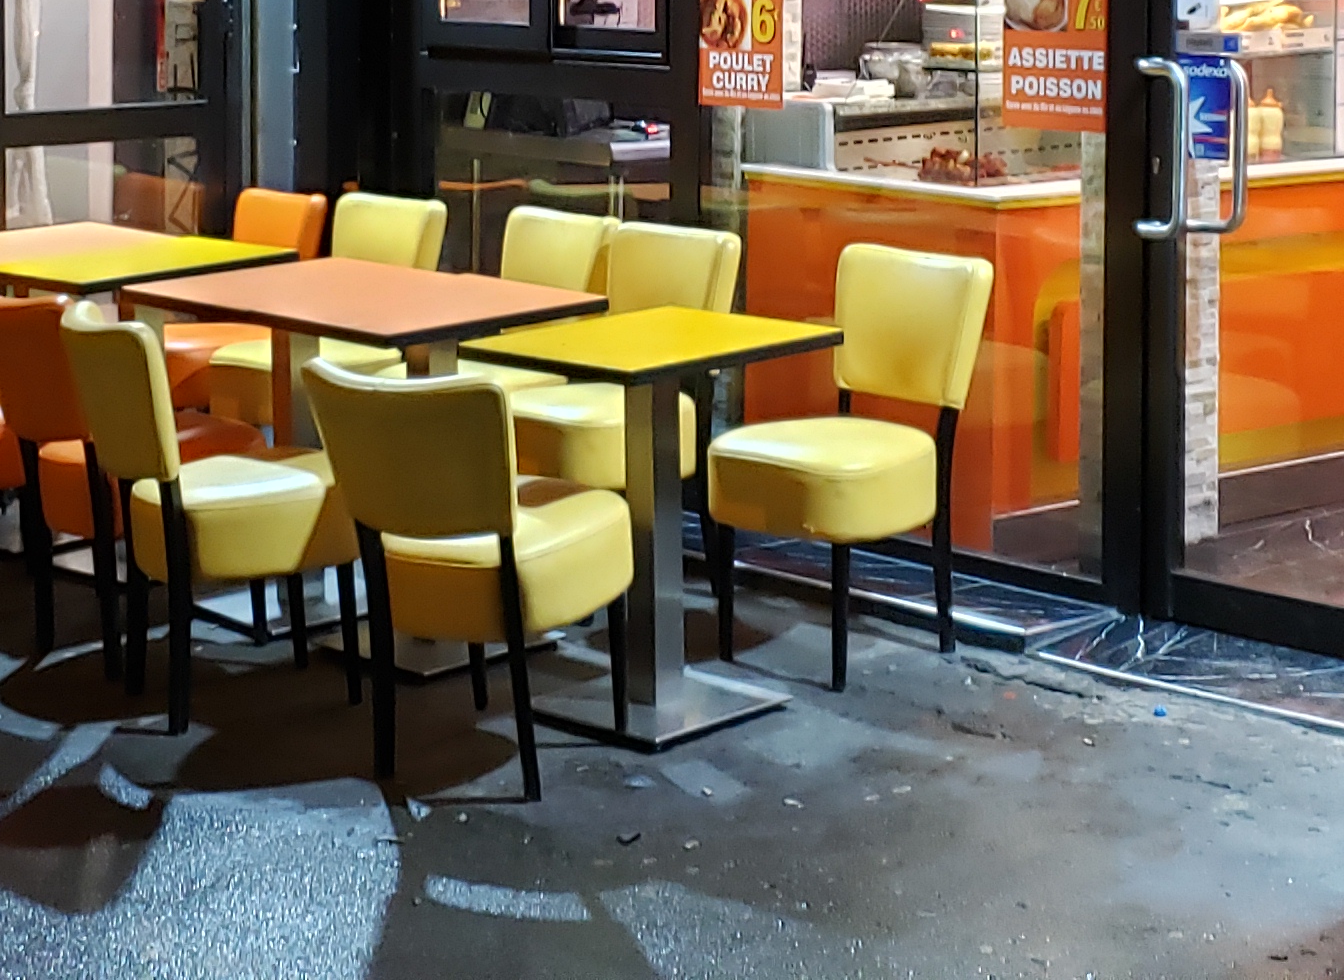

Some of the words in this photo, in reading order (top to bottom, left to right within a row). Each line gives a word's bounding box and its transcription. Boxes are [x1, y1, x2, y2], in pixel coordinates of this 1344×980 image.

[709, 51, 774, 72] POULET
[1008, 47, 1105, 71] ASSIETTE
[712, 70, 770, 92] CURRY
[1010, 74, 1103, 101] POISSON
